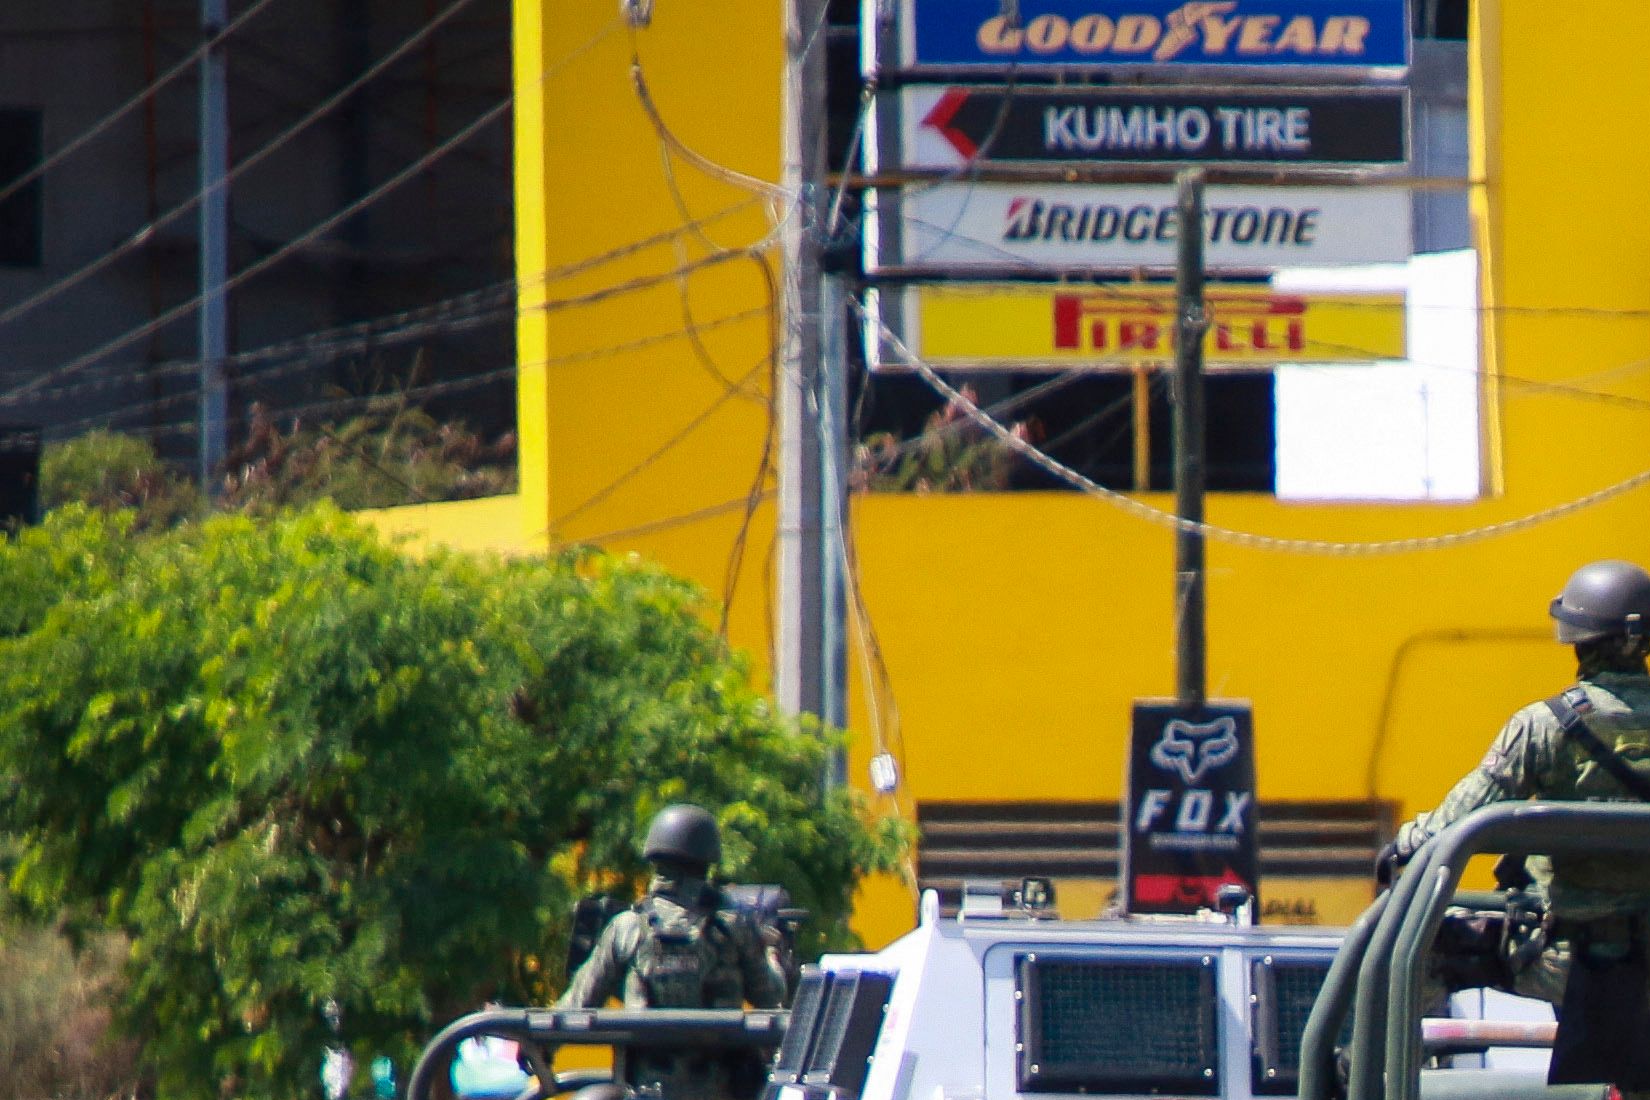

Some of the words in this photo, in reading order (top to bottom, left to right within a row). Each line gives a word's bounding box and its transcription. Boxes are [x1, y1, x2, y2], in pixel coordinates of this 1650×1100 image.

[1044, 107, 1209, 150] KUMHO
[1217, 107, 1311, 149] TIRE
[1003, 198, 1319, 245] BRIDGETONE
[1054, 293, 1307, 349] PIRLLI
[1135, 789, 1250, 833] FOX
